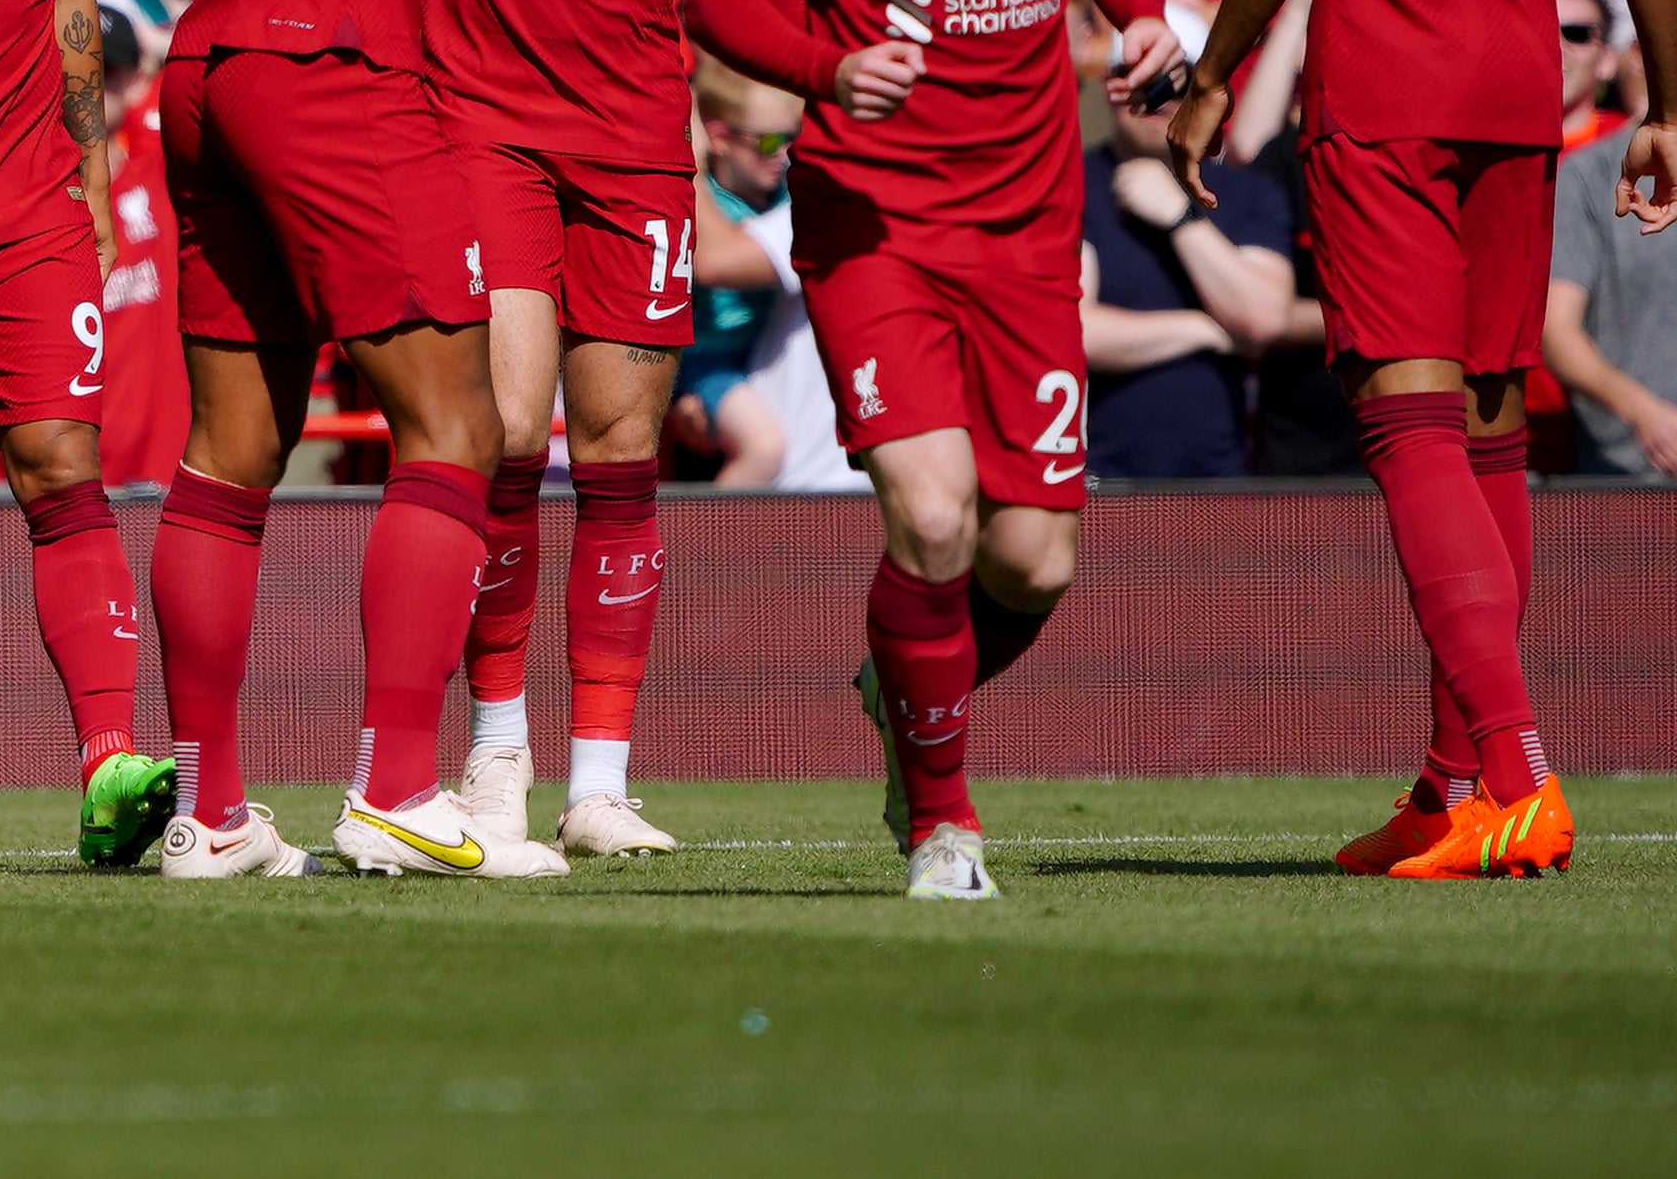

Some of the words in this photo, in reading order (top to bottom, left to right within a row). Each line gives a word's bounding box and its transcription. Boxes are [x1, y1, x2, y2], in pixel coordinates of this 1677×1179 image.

[644, 219, 693, 295] 14
[71, 301, 104, 375] 9
[1031, 369, 1089, 454] 2
